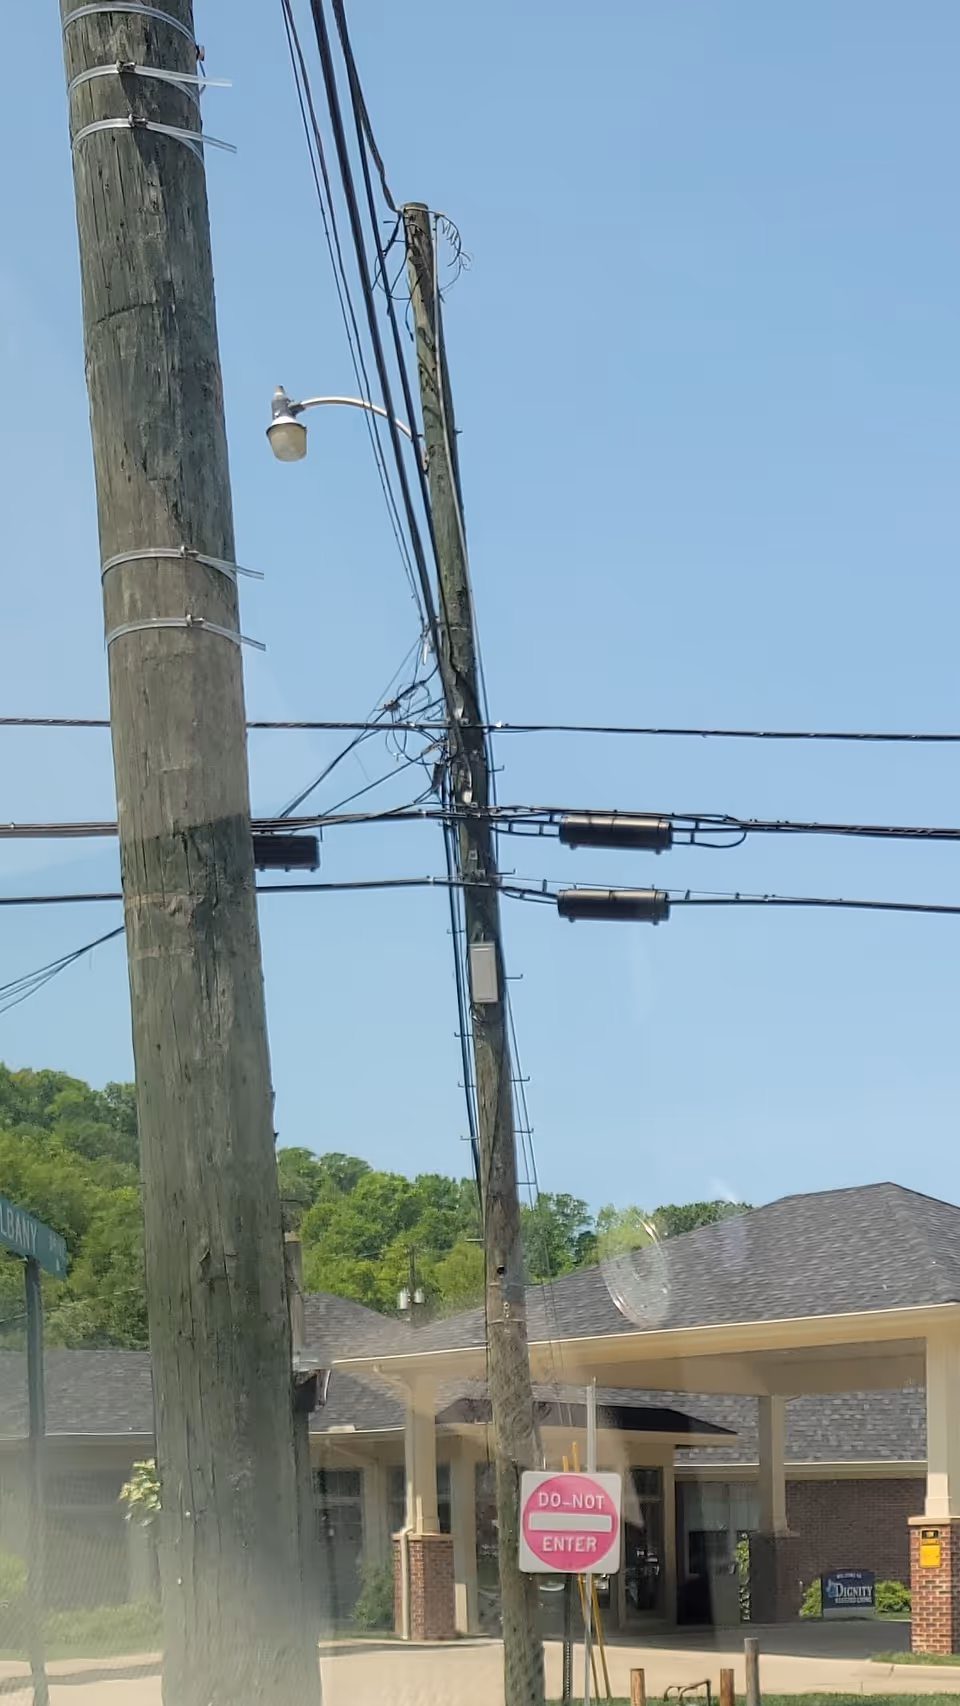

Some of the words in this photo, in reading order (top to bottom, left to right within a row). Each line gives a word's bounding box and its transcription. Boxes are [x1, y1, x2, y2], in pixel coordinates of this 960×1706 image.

[539, 1491, 561, 1508] DO
[572, 1493, 605, 1510] NOT
[543, 1535, 597, 1553] ENTER
